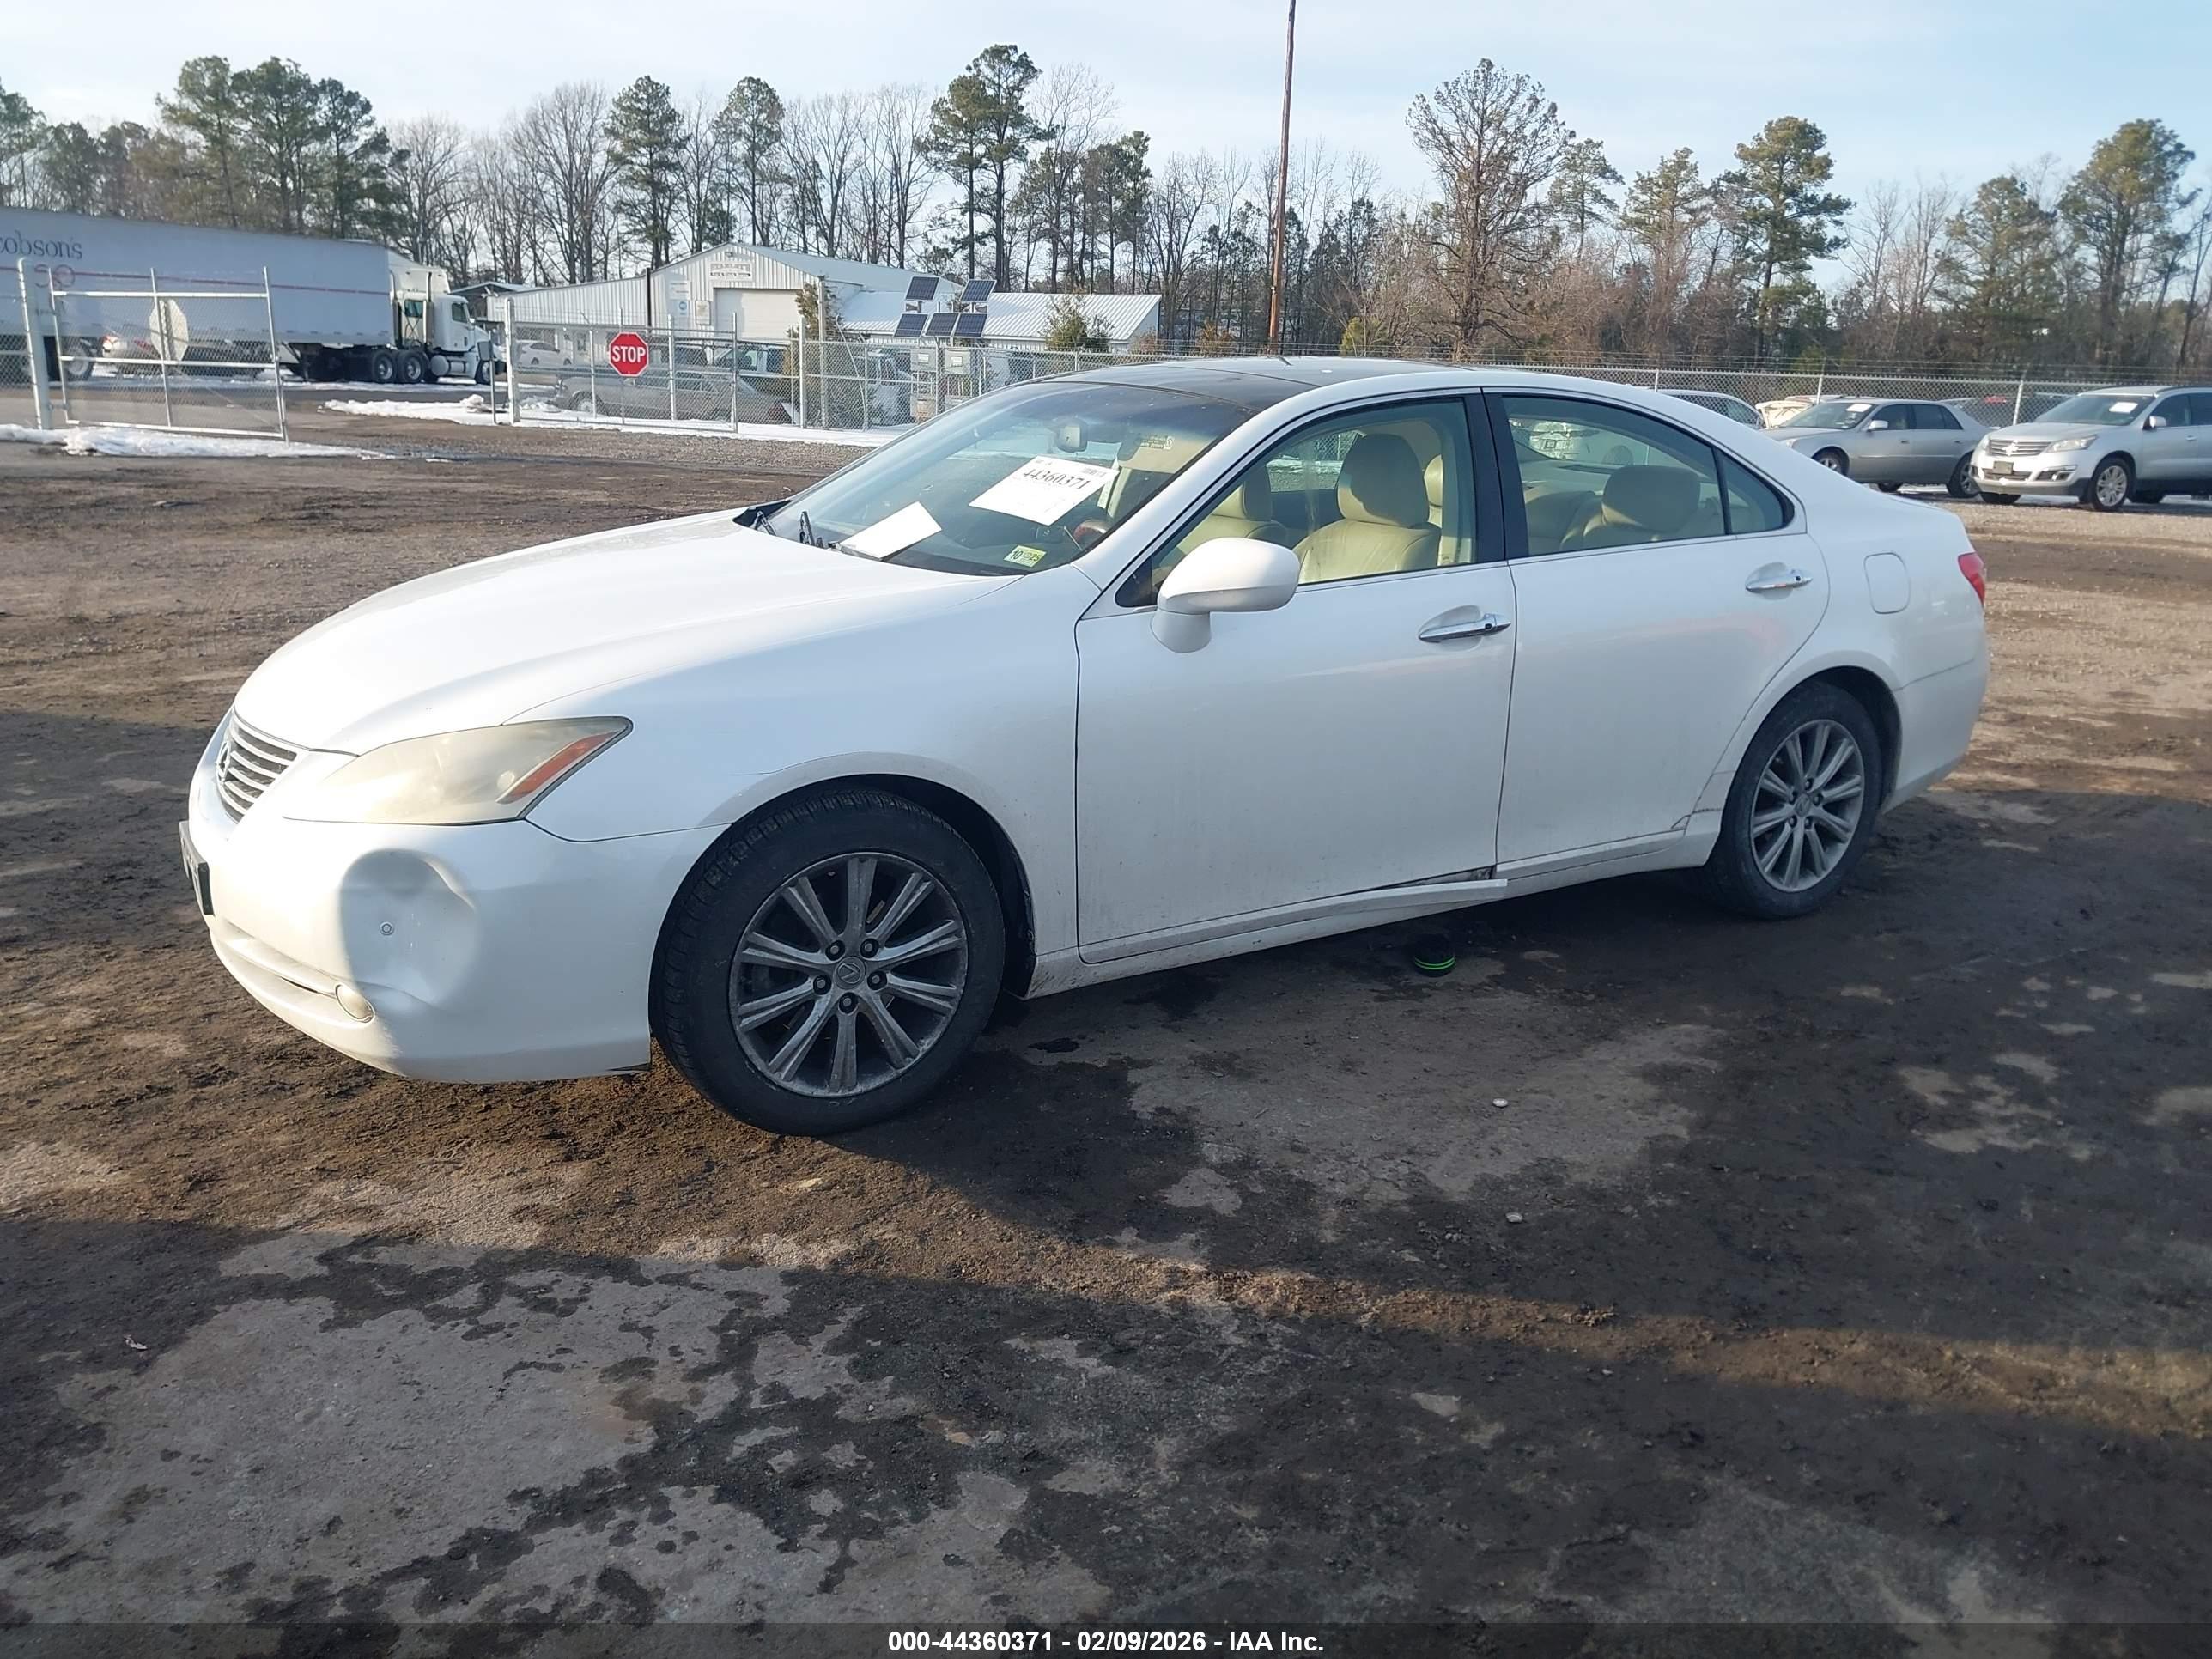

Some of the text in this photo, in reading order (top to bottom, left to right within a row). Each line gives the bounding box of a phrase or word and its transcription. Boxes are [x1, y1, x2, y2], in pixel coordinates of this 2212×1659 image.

[611, 345, 646, 363] STOP
[1023, 468, 1091, 489] 44360371
[1011, 550, 1042, 562] 10 25
